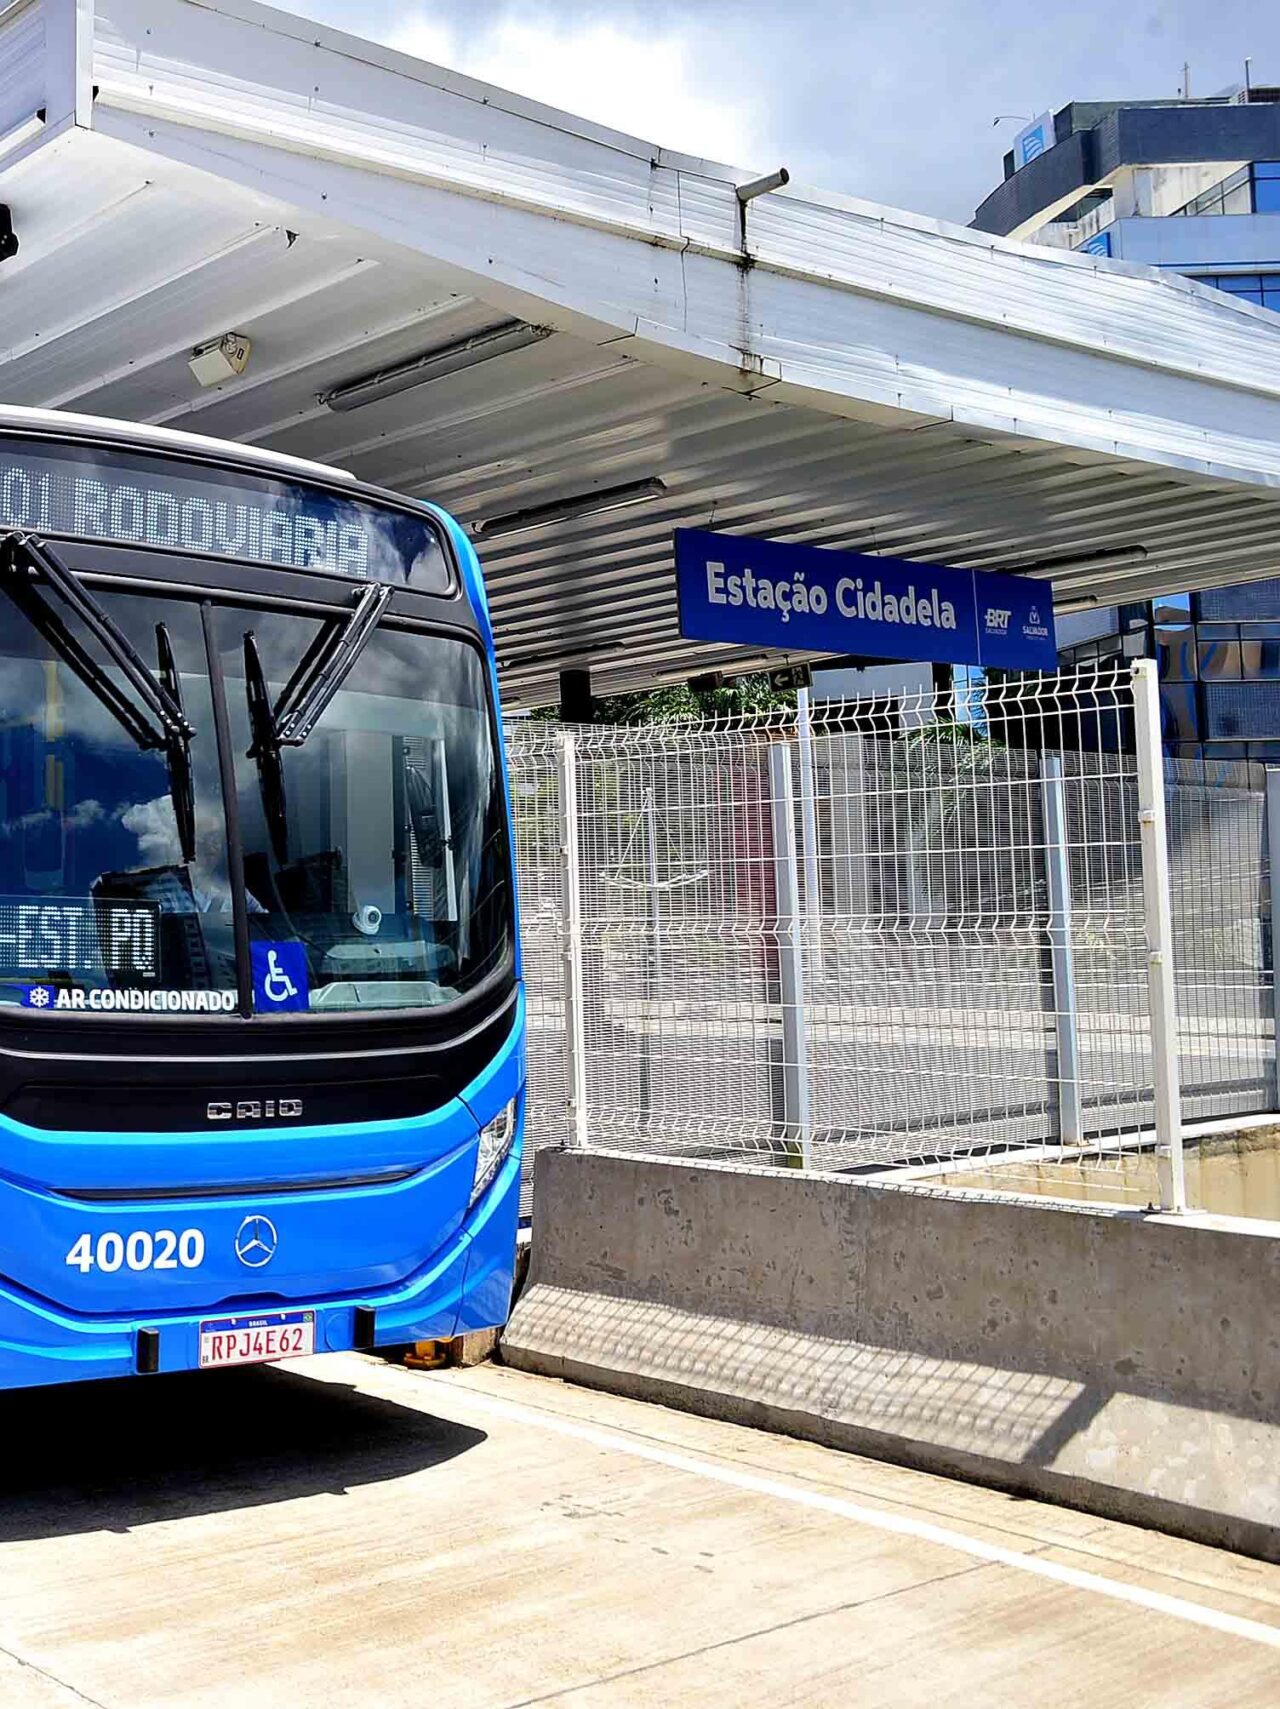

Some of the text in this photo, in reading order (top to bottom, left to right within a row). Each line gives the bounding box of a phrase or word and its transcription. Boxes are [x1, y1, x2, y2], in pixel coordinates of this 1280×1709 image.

[74, 478, 368, 579] RODOVIARIA
[705, 560, 957, 630] Estação Cidadela
[985, 608, 1012, 628] BRT
[56, 988, 235, 1011] AR CONDICIONADO
[65, 1228, 205, 1273] 40020
[211, 1328, 303, 1360] RPJ4E62
